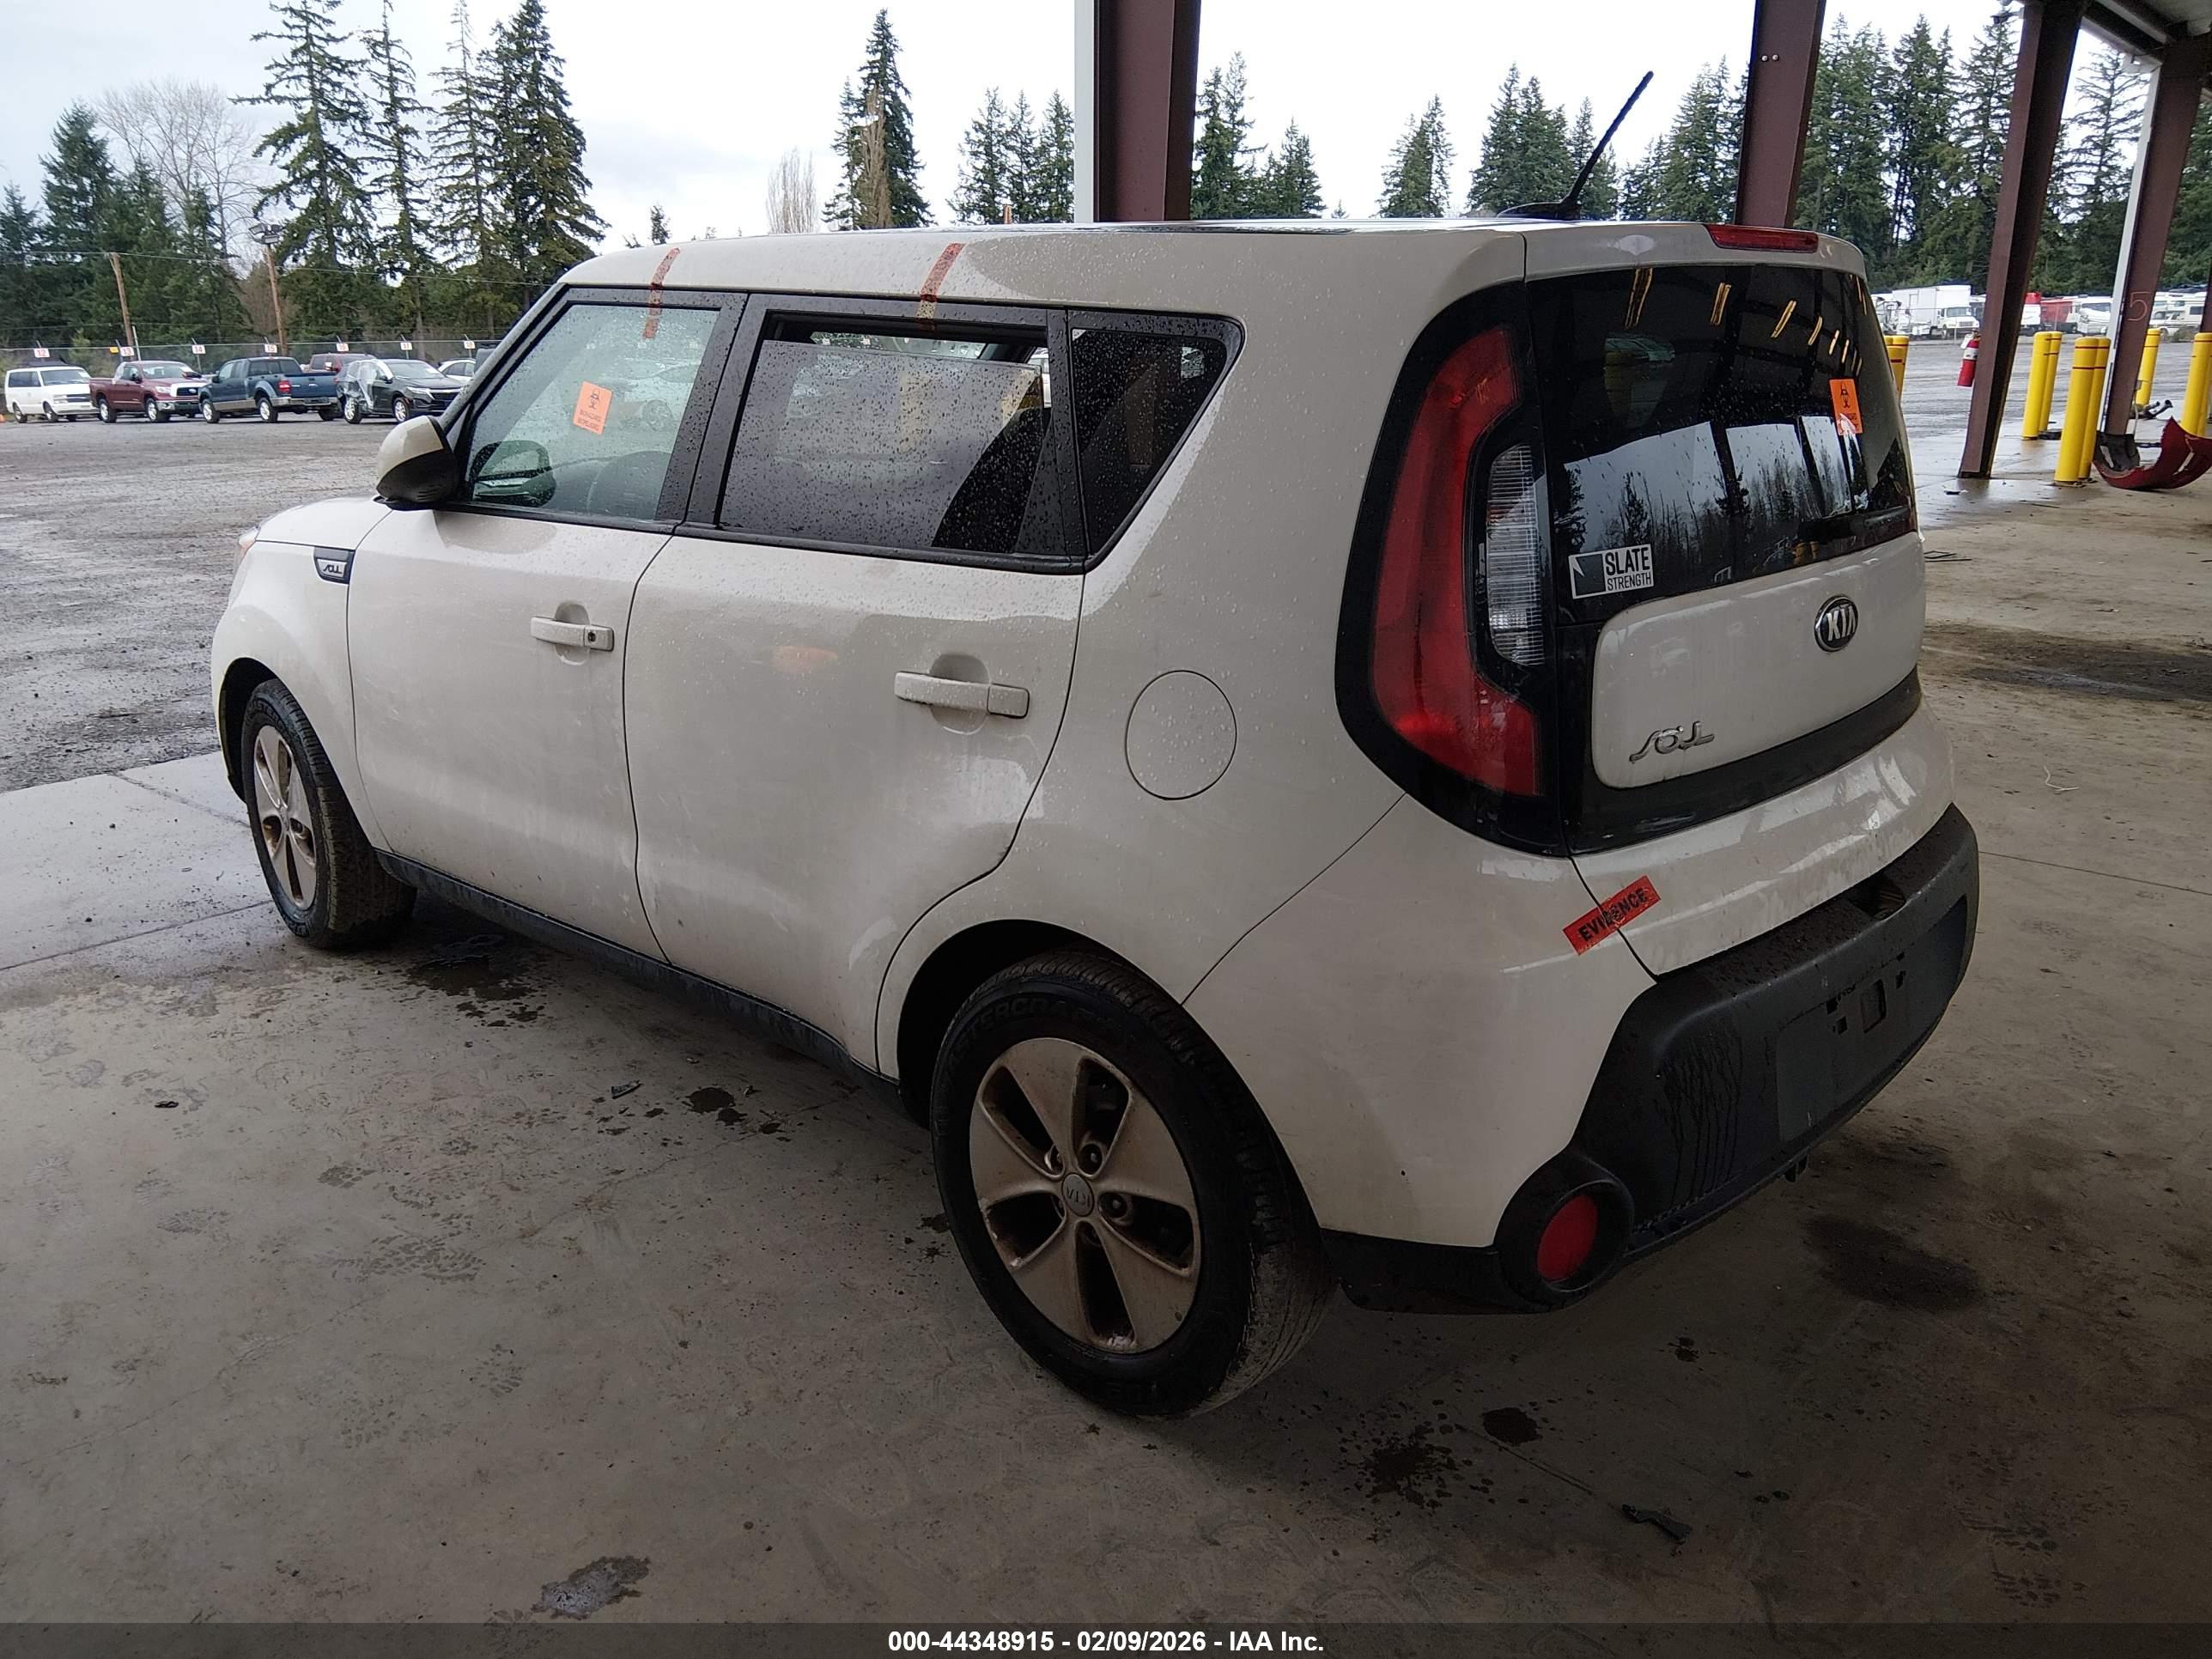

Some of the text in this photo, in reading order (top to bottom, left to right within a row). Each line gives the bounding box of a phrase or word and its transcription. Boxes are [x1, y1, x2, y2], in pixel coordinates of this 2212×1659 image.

[2127, 291, 2151, 321] 5
[1604, 547, 1650, 575] SLATE
[1607, 573, 1652, 591] STRENGTH
[1826, 604, 1856, 641] KIA
[1578, 887, 1647, 942] EVIDENCE
